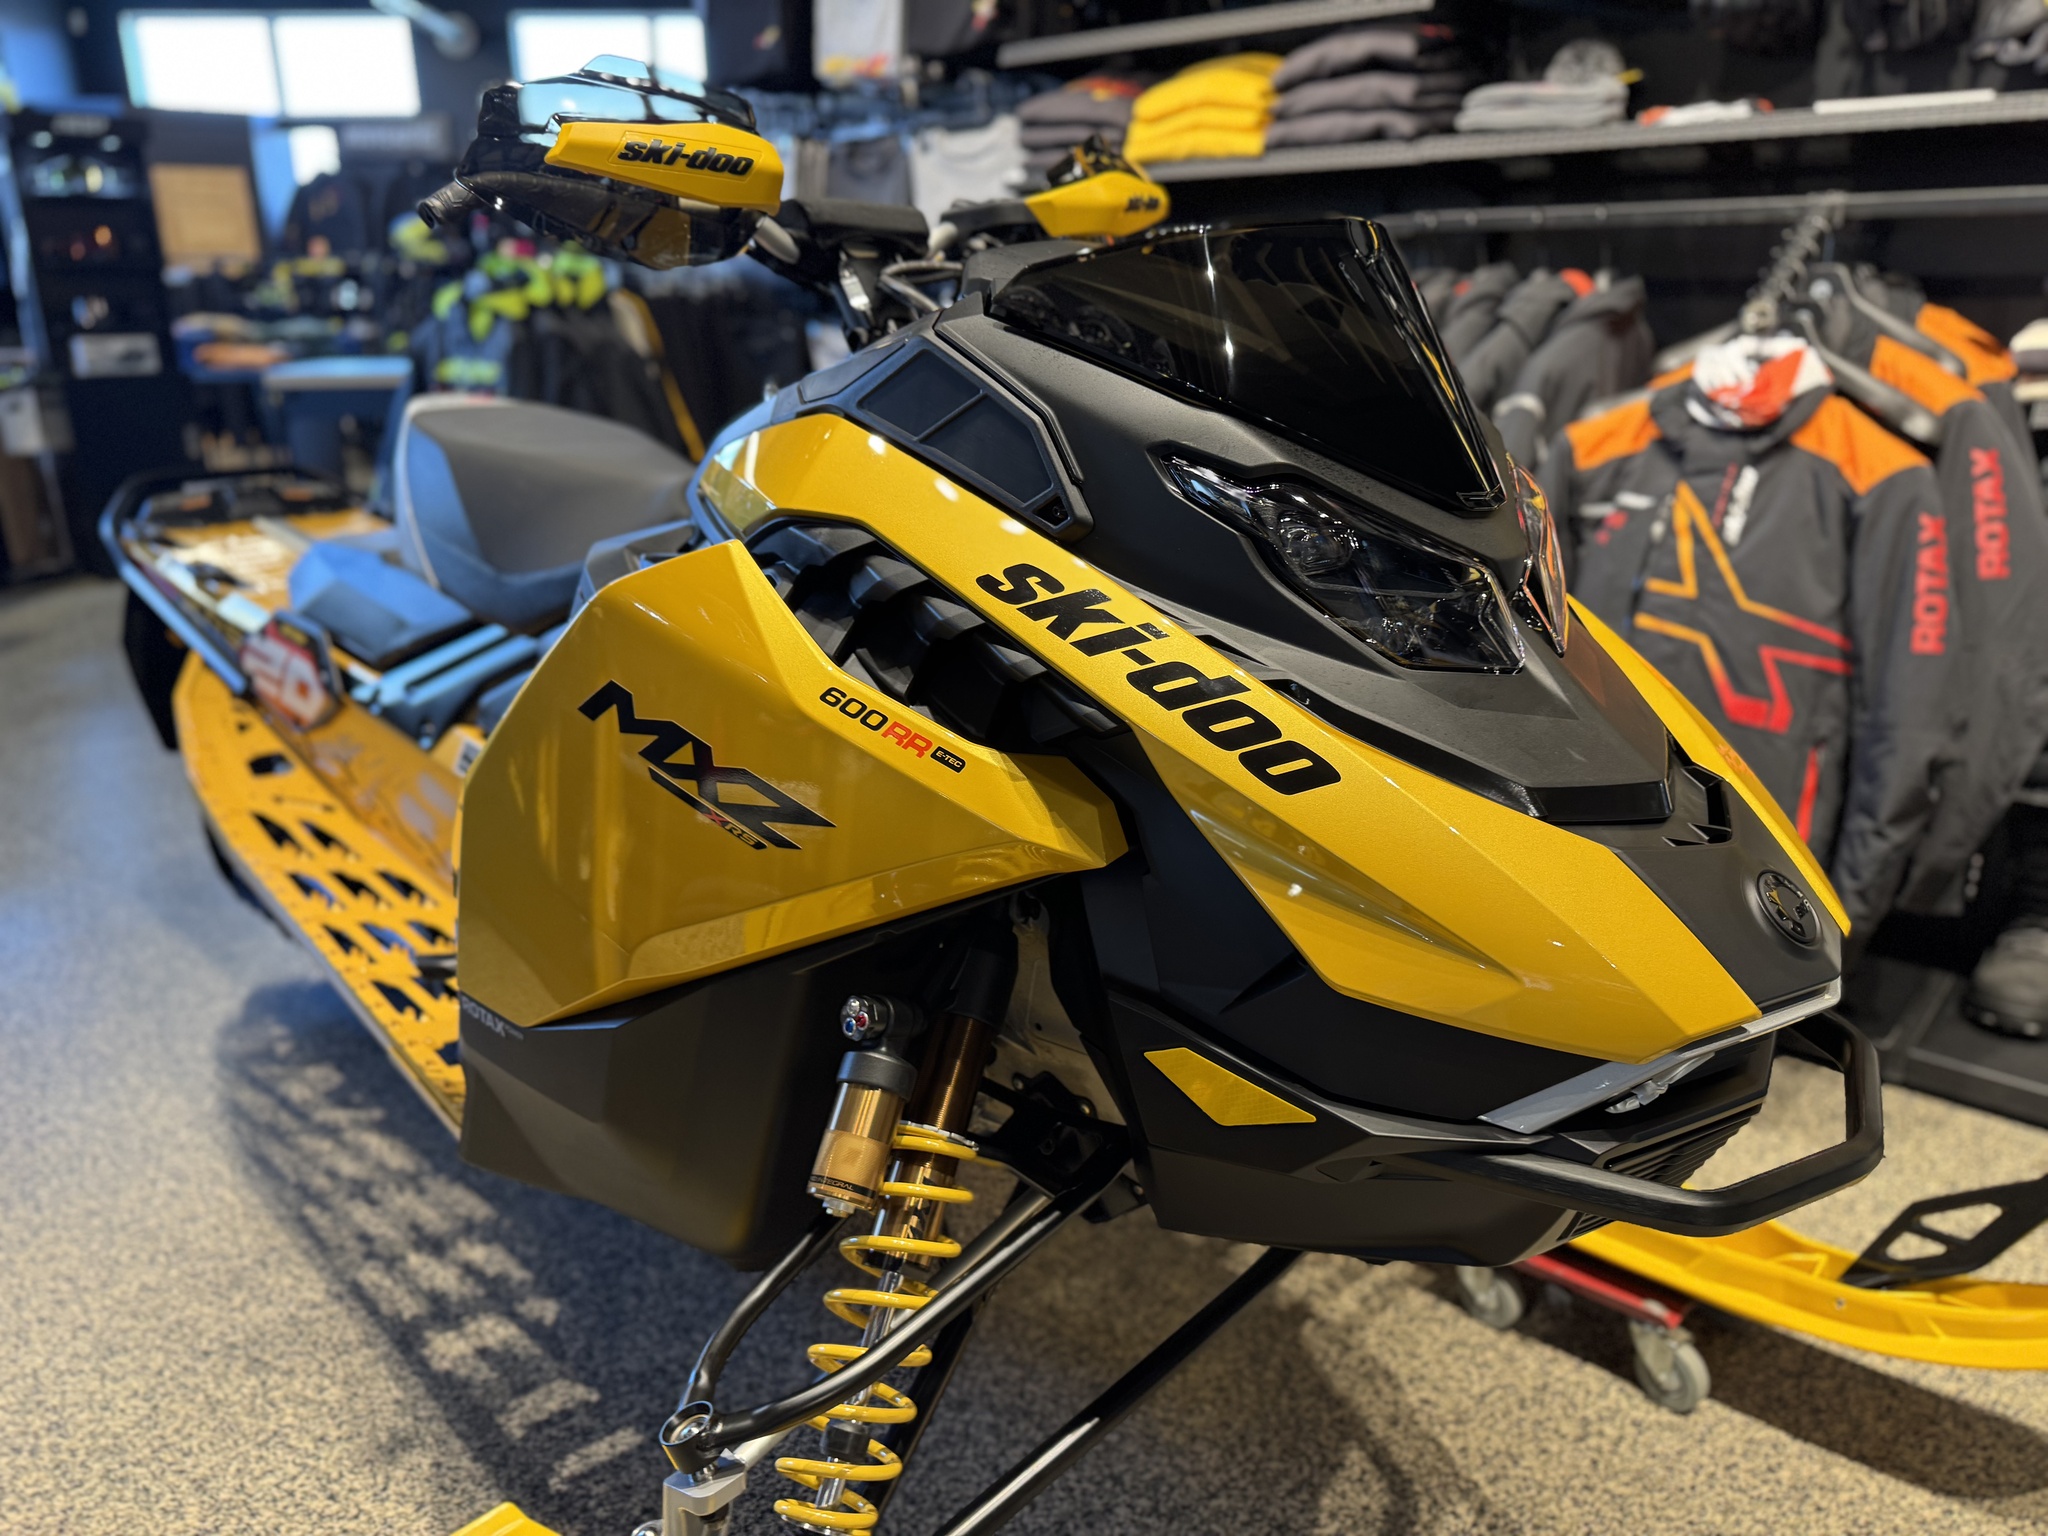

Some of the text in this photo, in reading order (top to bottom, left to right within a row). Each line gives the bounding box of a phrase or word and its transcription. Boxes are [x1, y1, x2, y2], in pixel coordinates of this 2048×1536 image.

[617, 139, 755, 176] ski-doo
[1969, 447, 2011, 580] ROTAX
[1910, 512, 1950, 655] ROTAX
[976, 563, 1342, 796] ski-doo
[577, 679, 837, 850] MXZ
[935, 750, 963, 769] E-TEC
